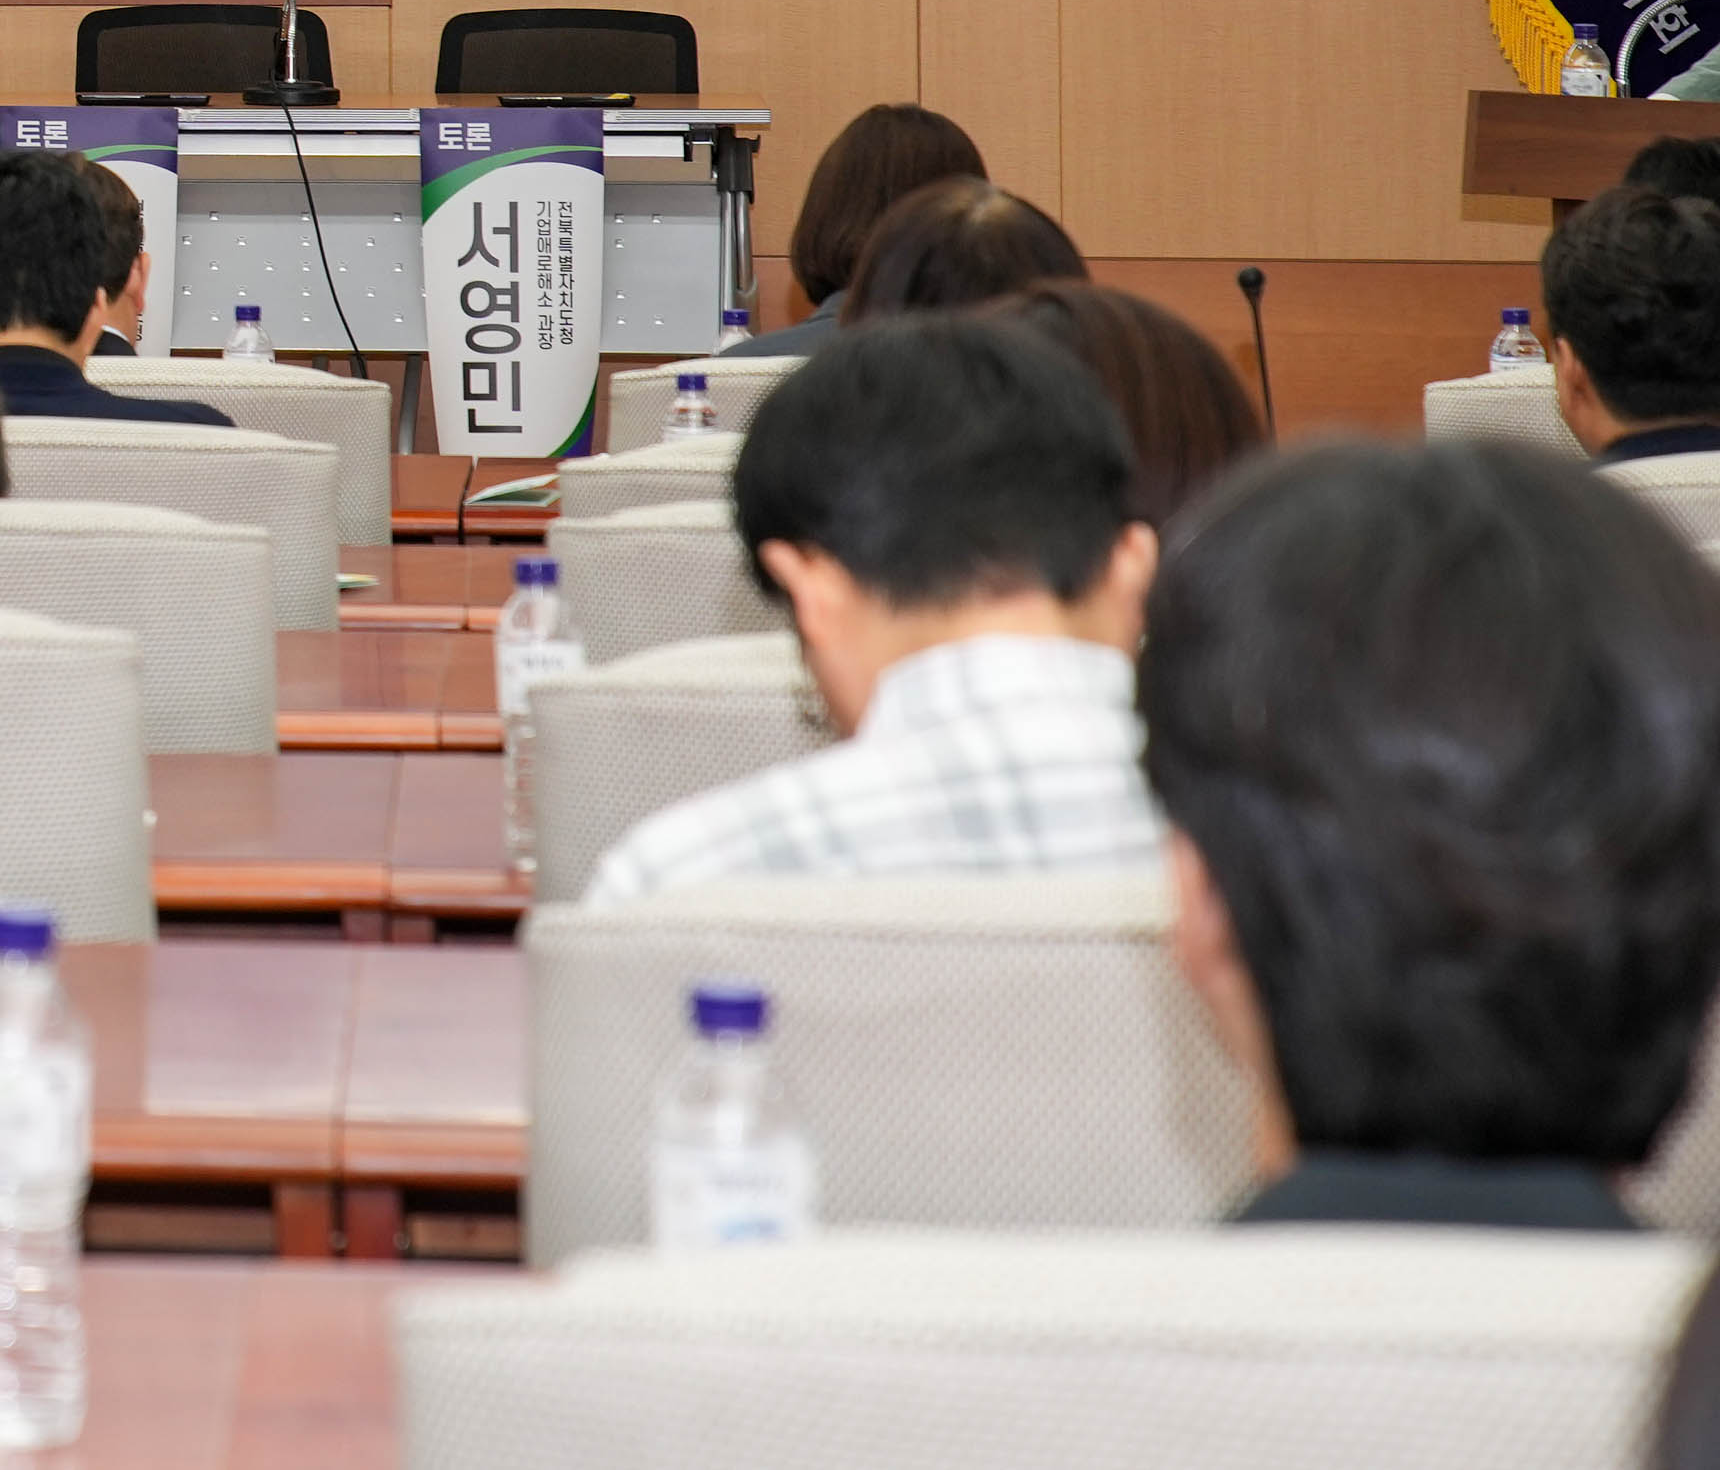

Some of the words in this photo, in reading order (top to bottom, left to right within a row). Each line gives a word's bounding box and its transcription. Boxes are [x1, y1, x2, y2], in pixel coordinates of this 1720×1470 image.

[15, 120, 69, 149] 토론
[437, 122, 493, 151] 토론
[536, 201, 553, 309] 기업애로해소
[557, 201, 575, 346] 전북특별자치도청
[456, 201, 523, 434] 서영민
[537, 314, 555, 351] 과장
